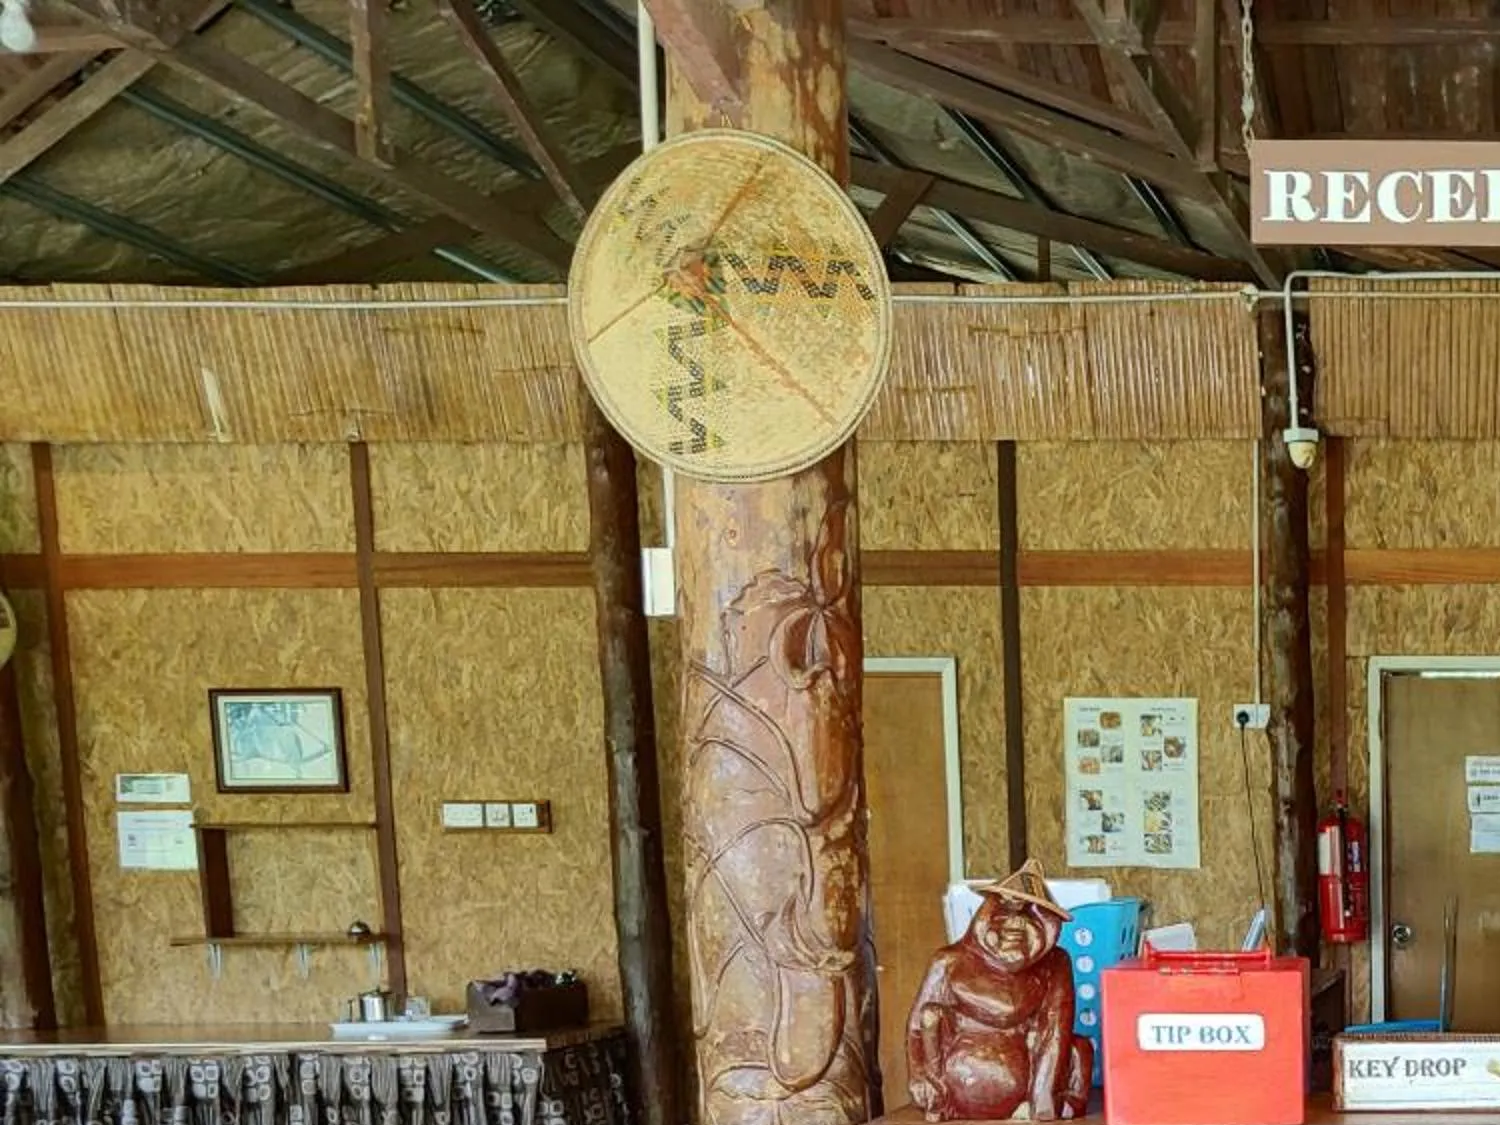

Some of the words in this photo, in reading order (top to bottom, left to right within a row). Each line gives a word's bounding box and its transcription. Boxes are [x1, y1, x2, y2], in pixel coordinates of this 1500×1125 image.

[1151, 1024, 1190, 1044] TIP
[1199, 1025, 1252, 1044] BOX
[1348, 1056, 1399, 1078] KEY
[1404, 1058, 1467, 1078] DROP
